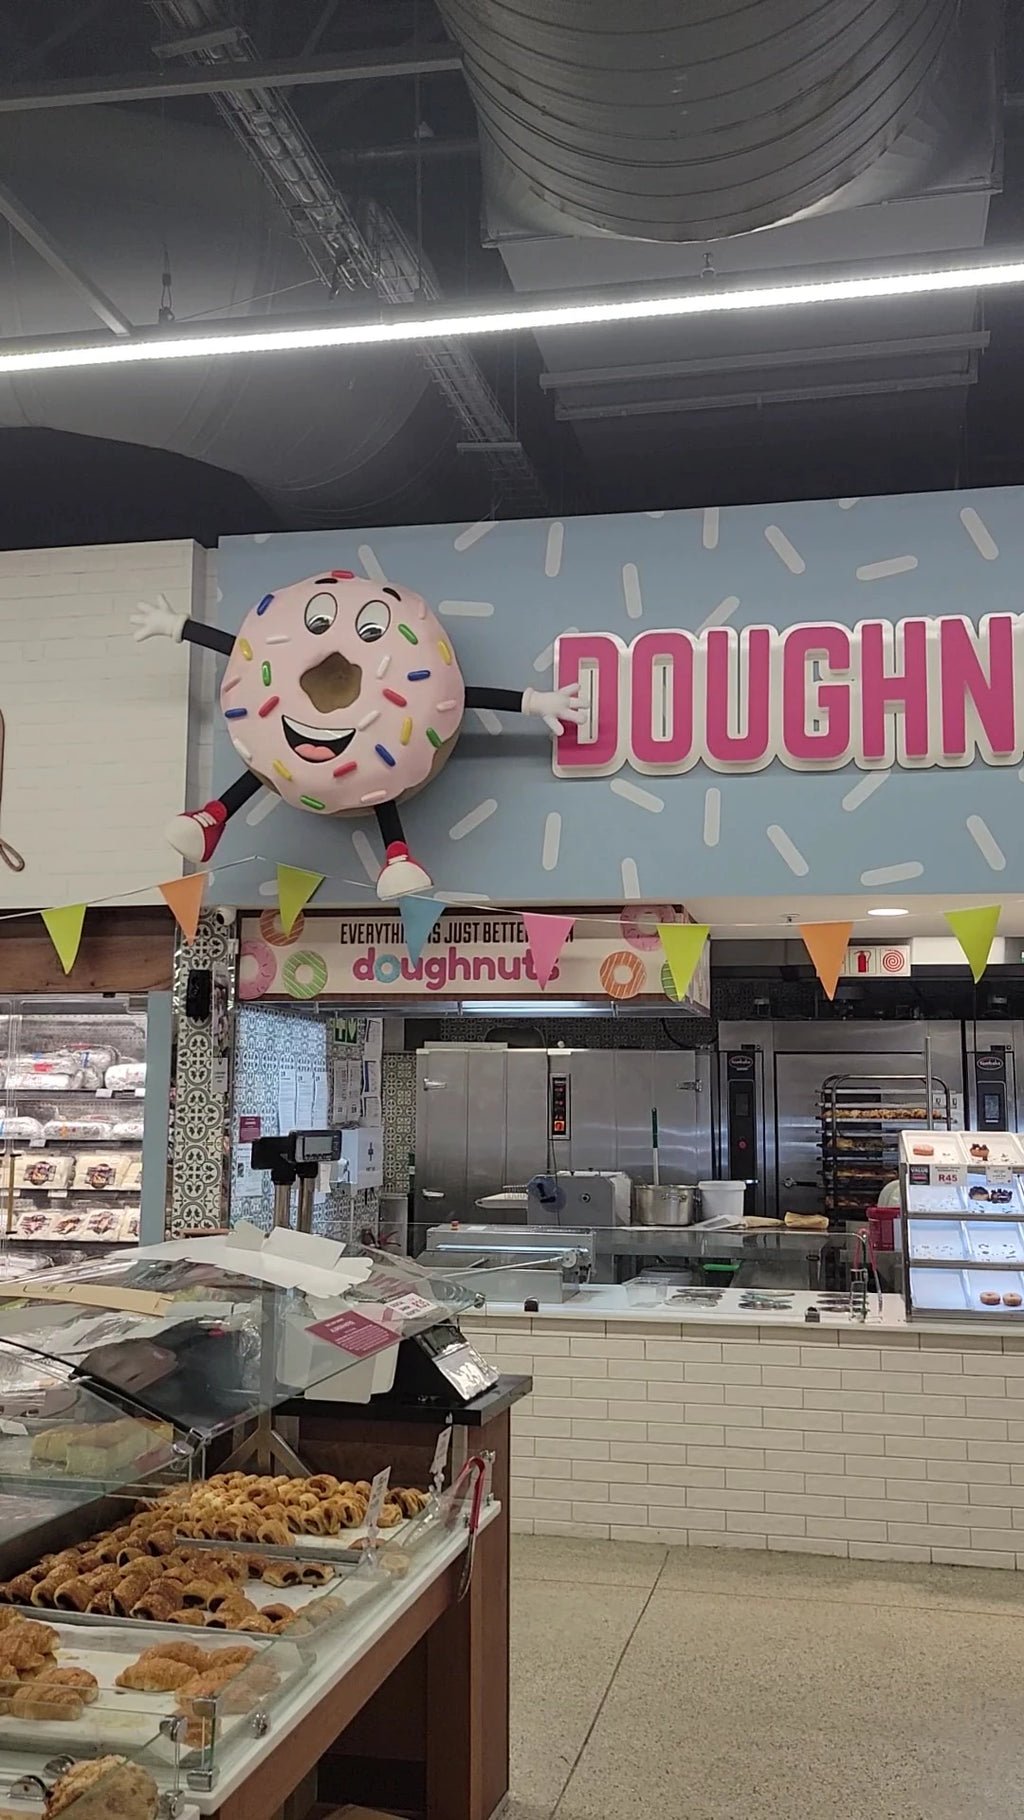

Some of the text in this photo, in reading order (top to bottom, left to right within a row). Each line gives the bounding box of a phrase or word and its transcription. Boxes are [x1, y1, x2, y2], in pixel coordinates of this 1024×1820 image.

[340, 922, 408, 944] EVERYTHI
[444, 922, 480, 943] JUST
[938, 1173, 958, 1182] R45
